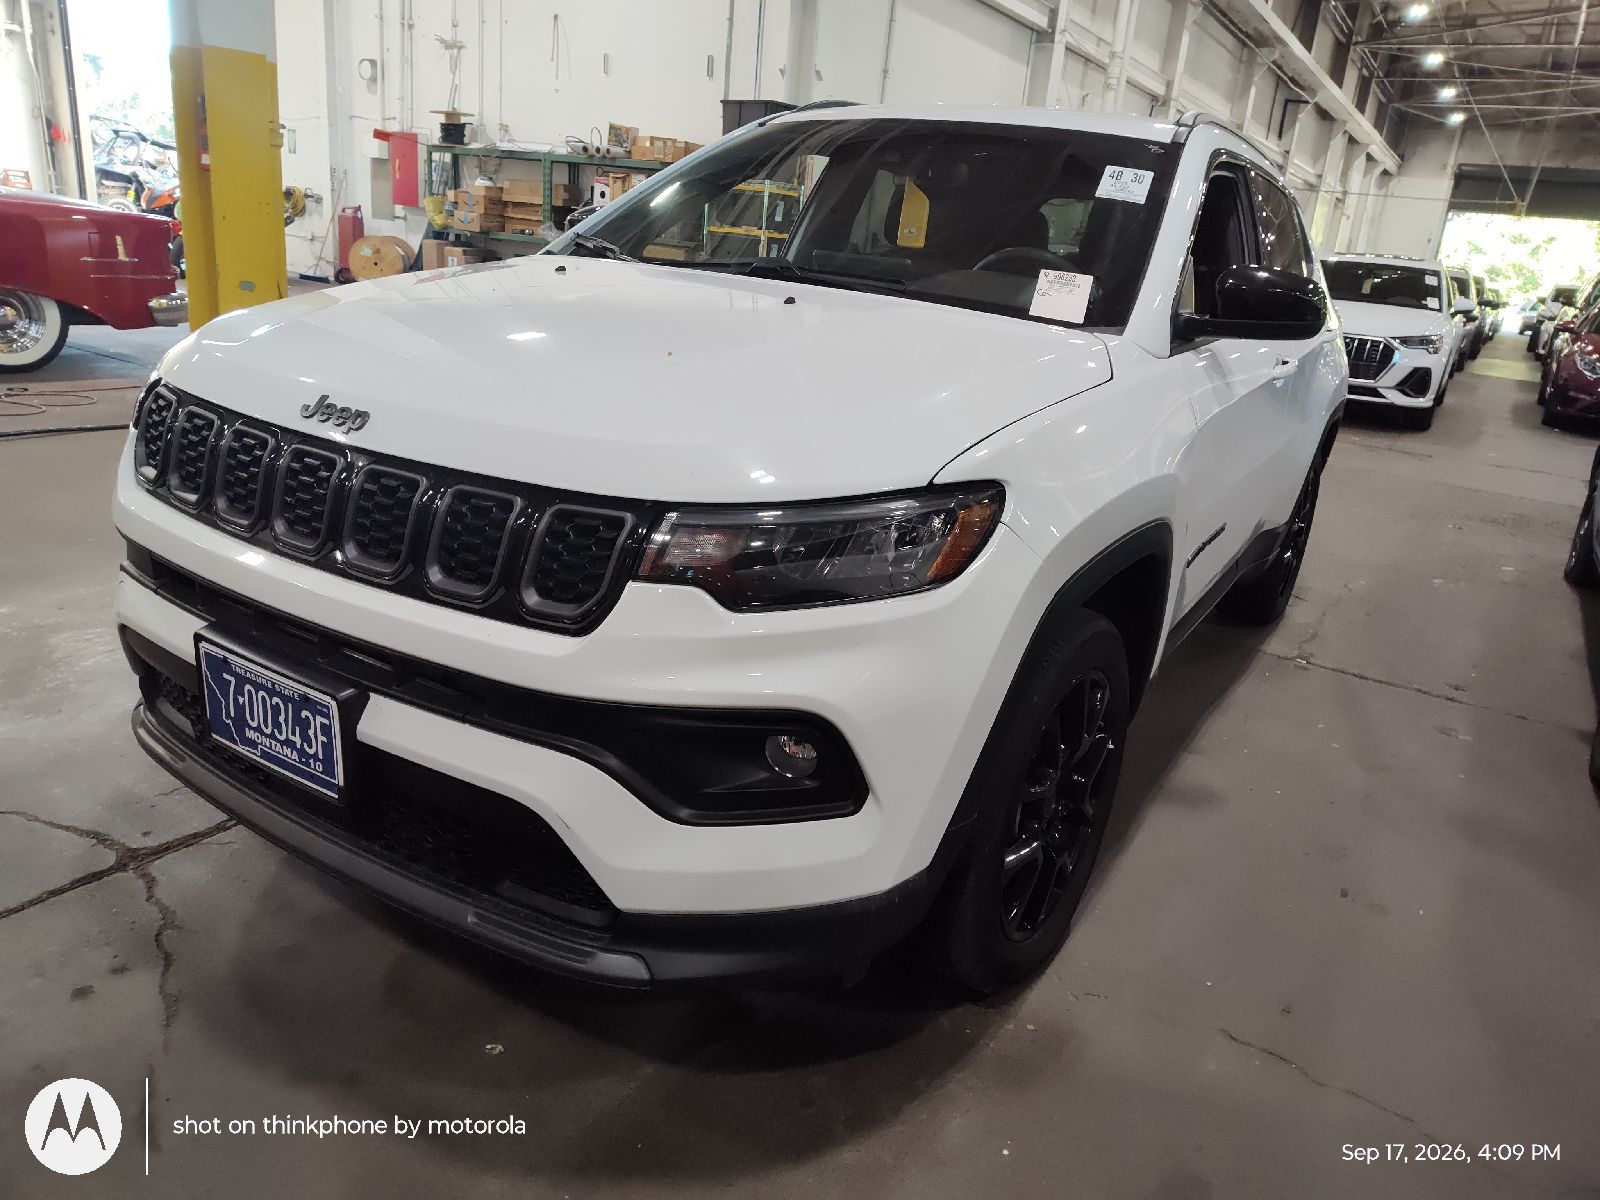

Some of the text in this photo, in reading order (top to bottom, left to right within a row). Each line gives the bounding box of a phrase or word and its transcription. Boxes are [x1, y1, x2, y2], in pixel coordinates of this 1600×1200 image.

[1108, 170, 1146, 185] 4B 30
[300, 394, 371, 435] Jeep
[231, 664, 300, 701] TREASURE STATE
[245, 727, 300, 762] MONTANA
[310, 758, 323, 772] 10
